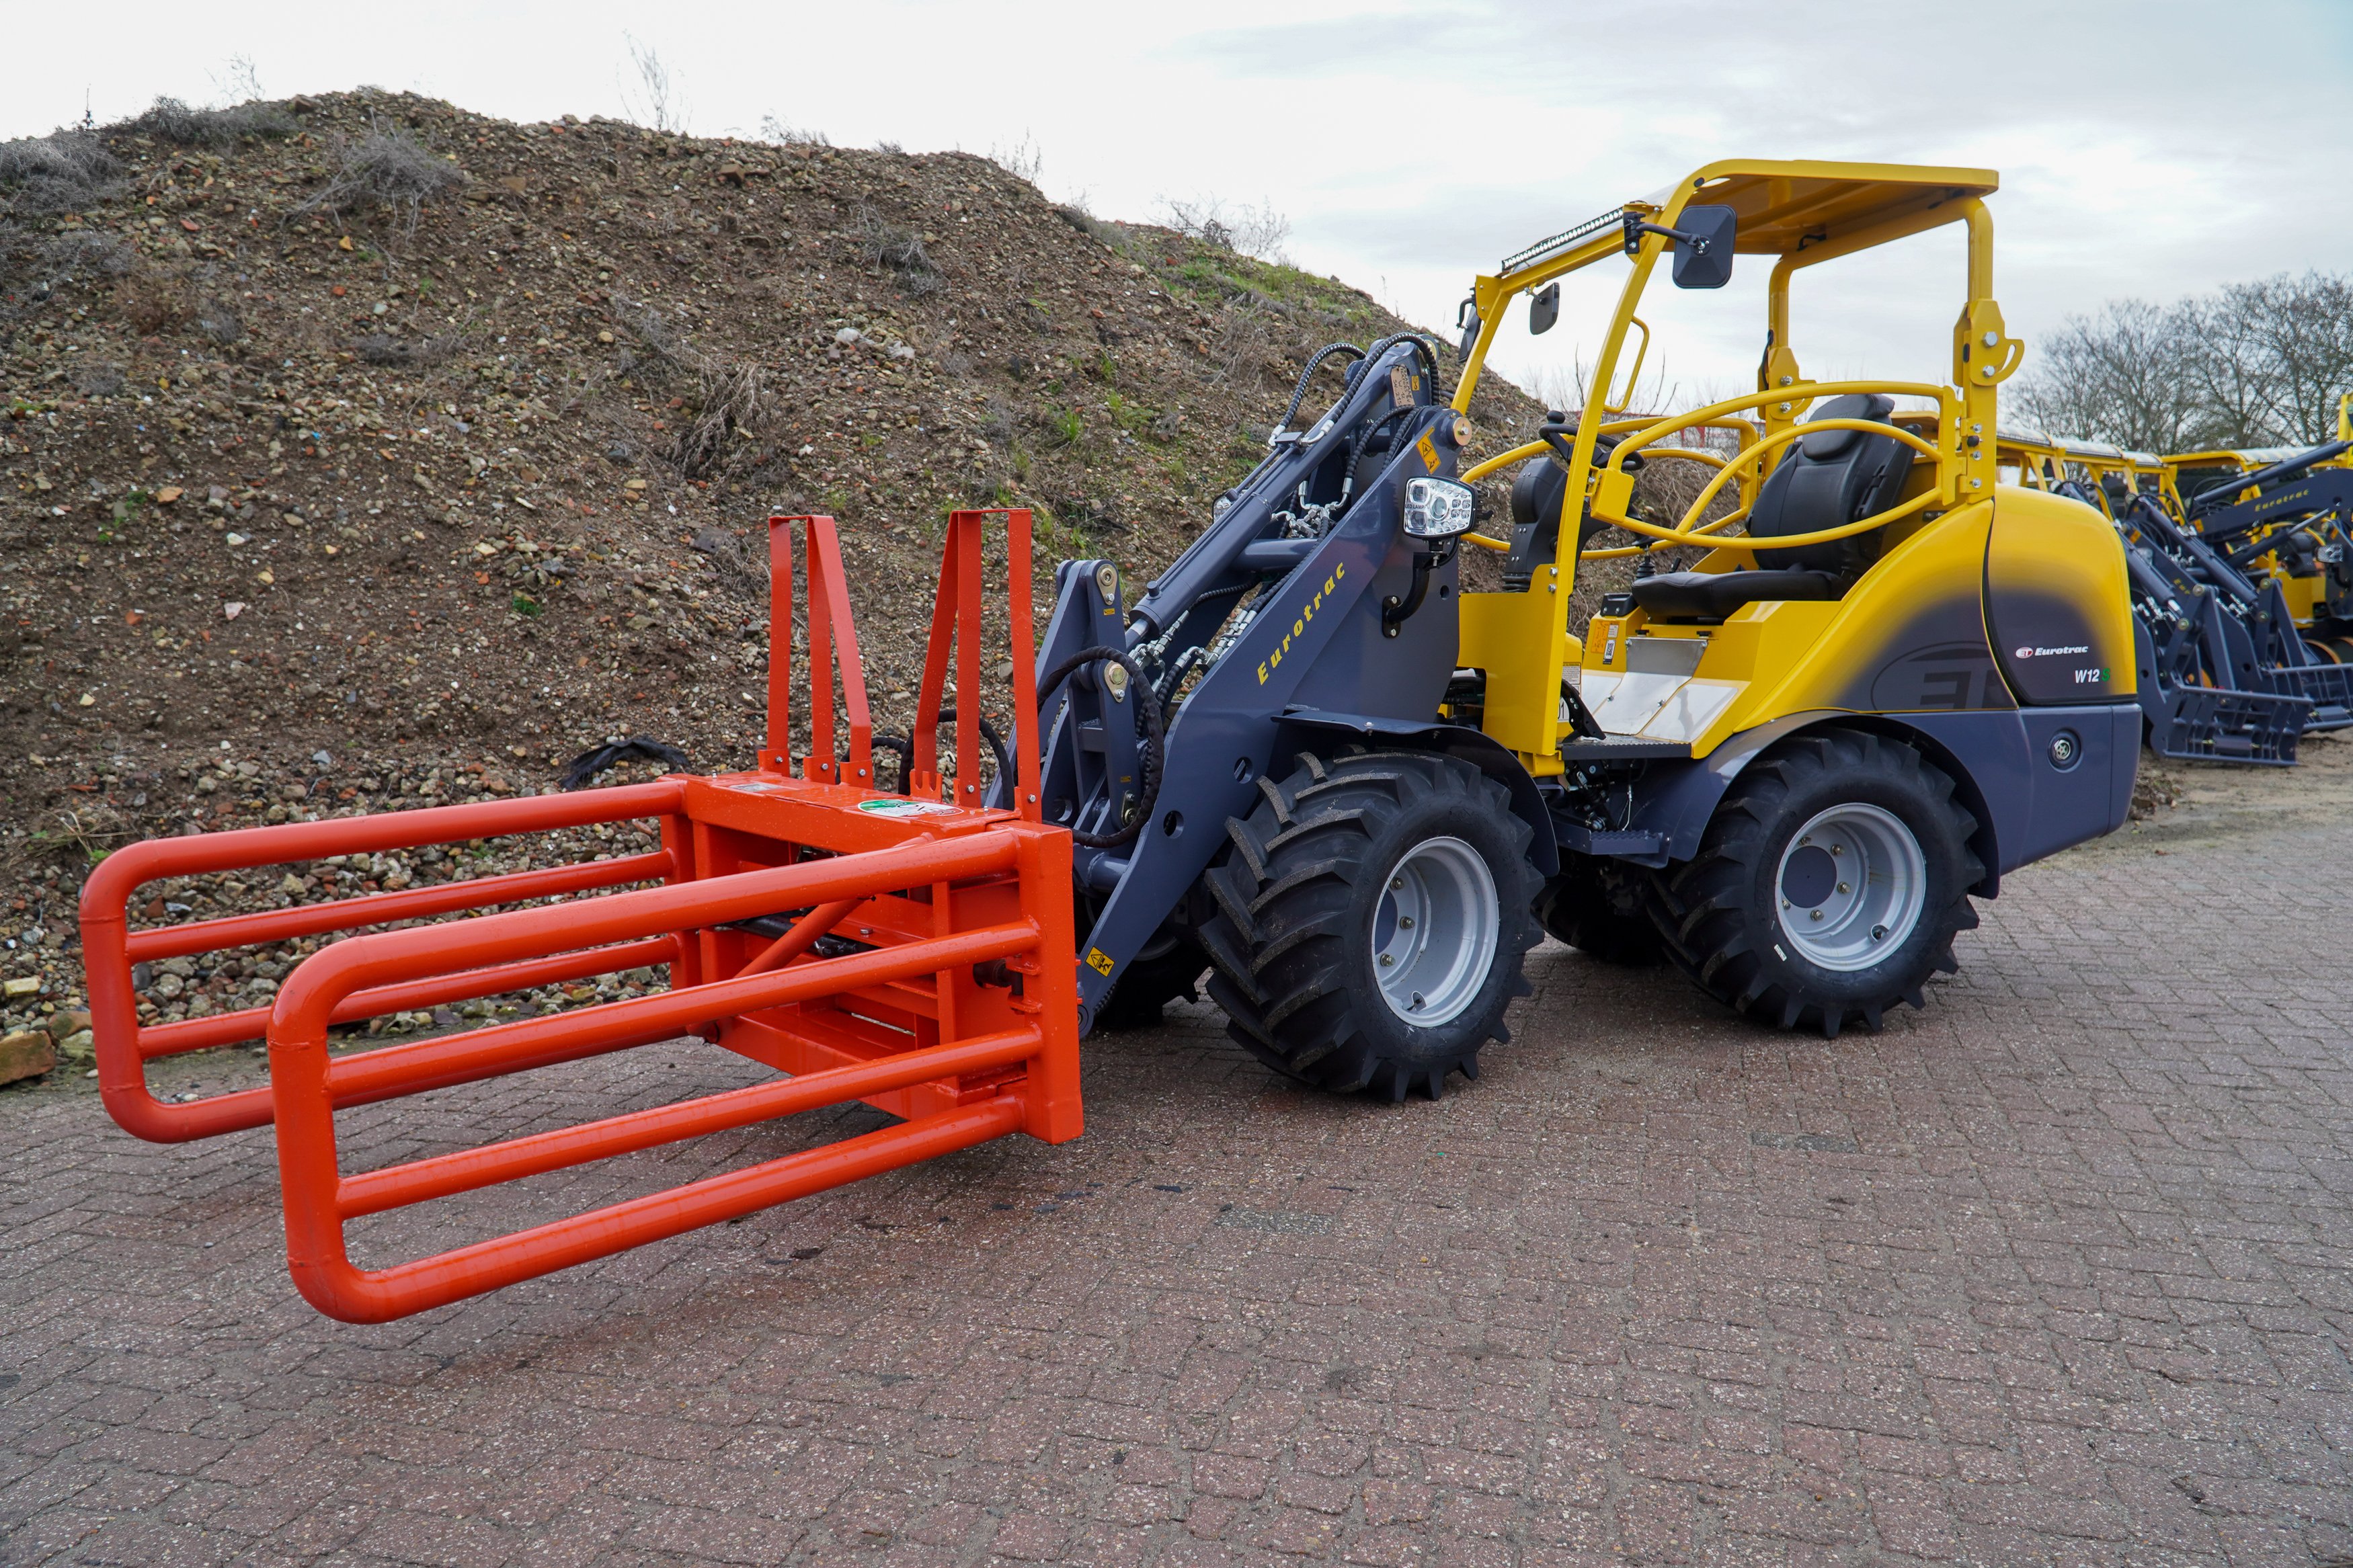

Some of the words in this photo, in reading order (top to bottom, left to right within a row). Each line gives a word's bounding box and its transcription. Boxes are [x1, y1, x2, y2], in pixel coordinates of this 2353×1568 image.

[1257, 562, 1345, 686] Eurotrac
[2034, 645, 2089, 656] Eurotrac
[2075, 669, 2100, 684] W12
[2102, 668, 2110, 682] S
